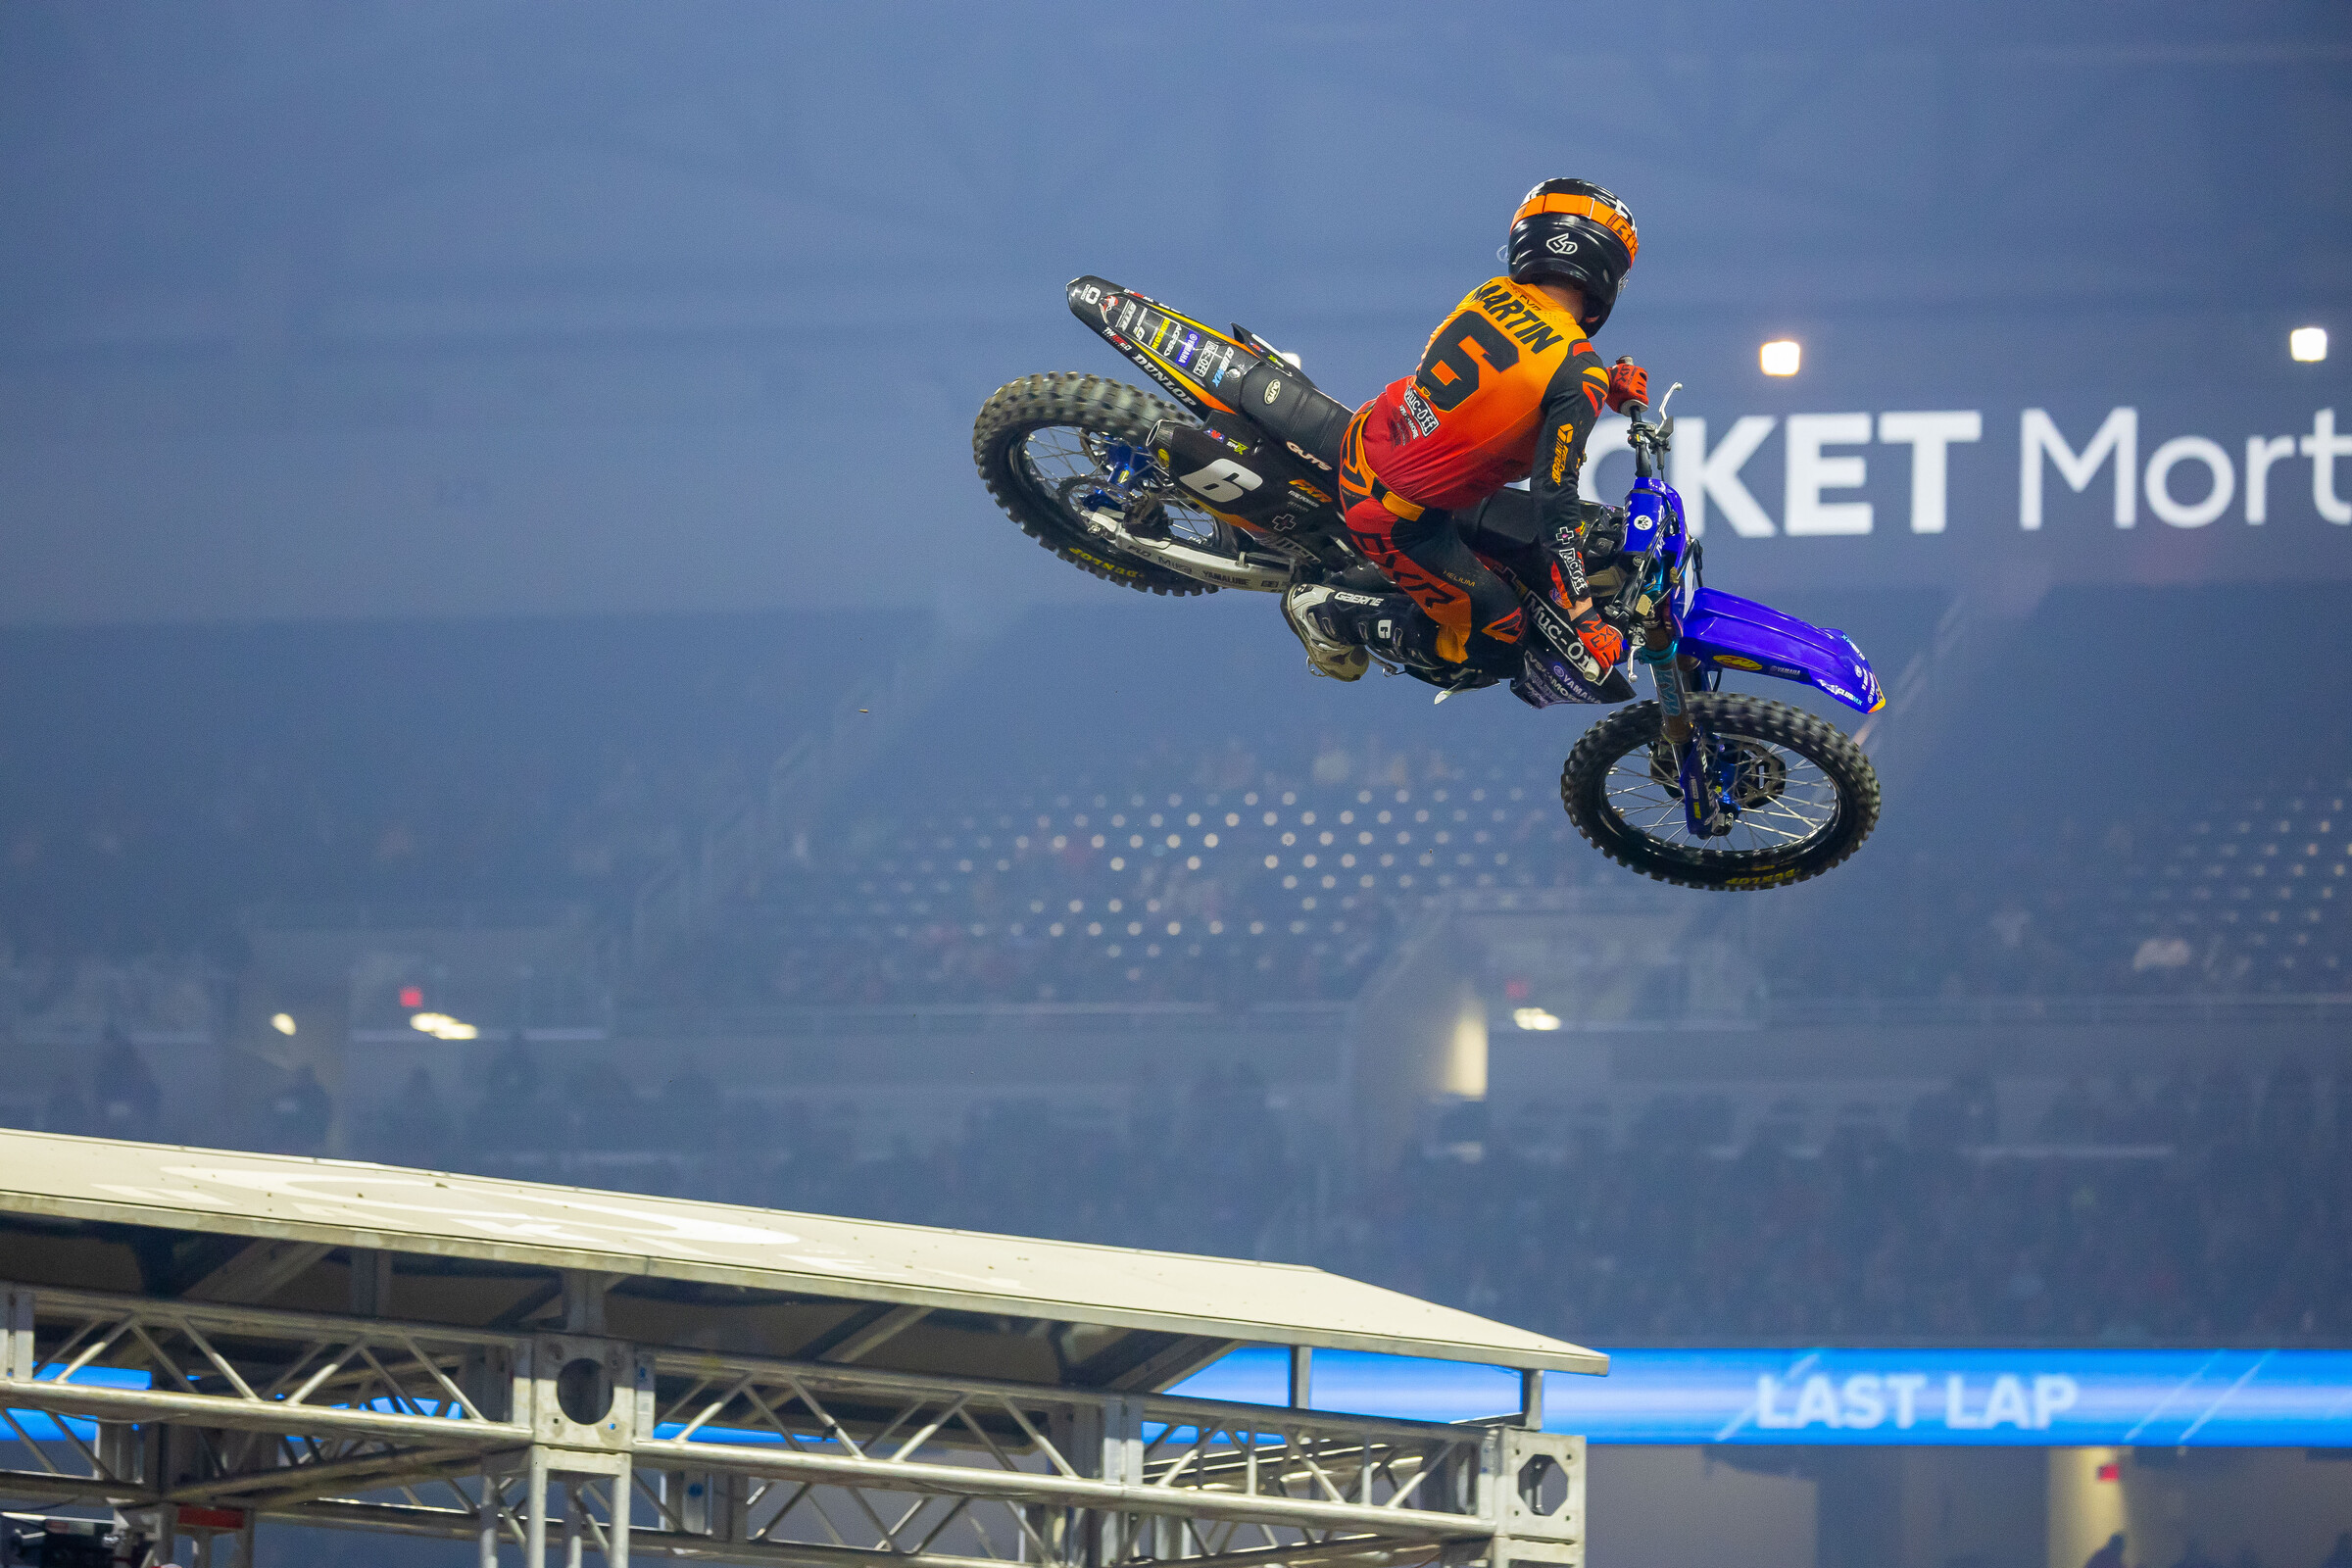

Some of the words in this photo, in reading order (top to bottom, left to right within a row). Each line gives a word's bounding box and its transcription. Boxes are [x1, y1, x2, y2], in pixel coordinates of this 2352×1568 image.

[1471, 280, 1564, 355] MARTIN
[1178, 340, 1196, 365] YAMAHA
[1416, 310, 1520, 413] 6
[1132, 353, 1198, 408] DUNLOP
[1405, 387, 1437, 434] Muc-Off
[1286, 440, 1333, 471] GUTS
[1179, 458, 1263, 502] 6
[1068, 547, 1139, 578] DUNLOP
[1443, 569, 1476, 587] HELIUM
[1563, 672, 1602, 705] YAMAHA
[1837, 687, 1863, 707] CLUBMX
[1756, 1373, 1927, 1430] LAST
[1945, 1373, 2079, 1430] LAP
